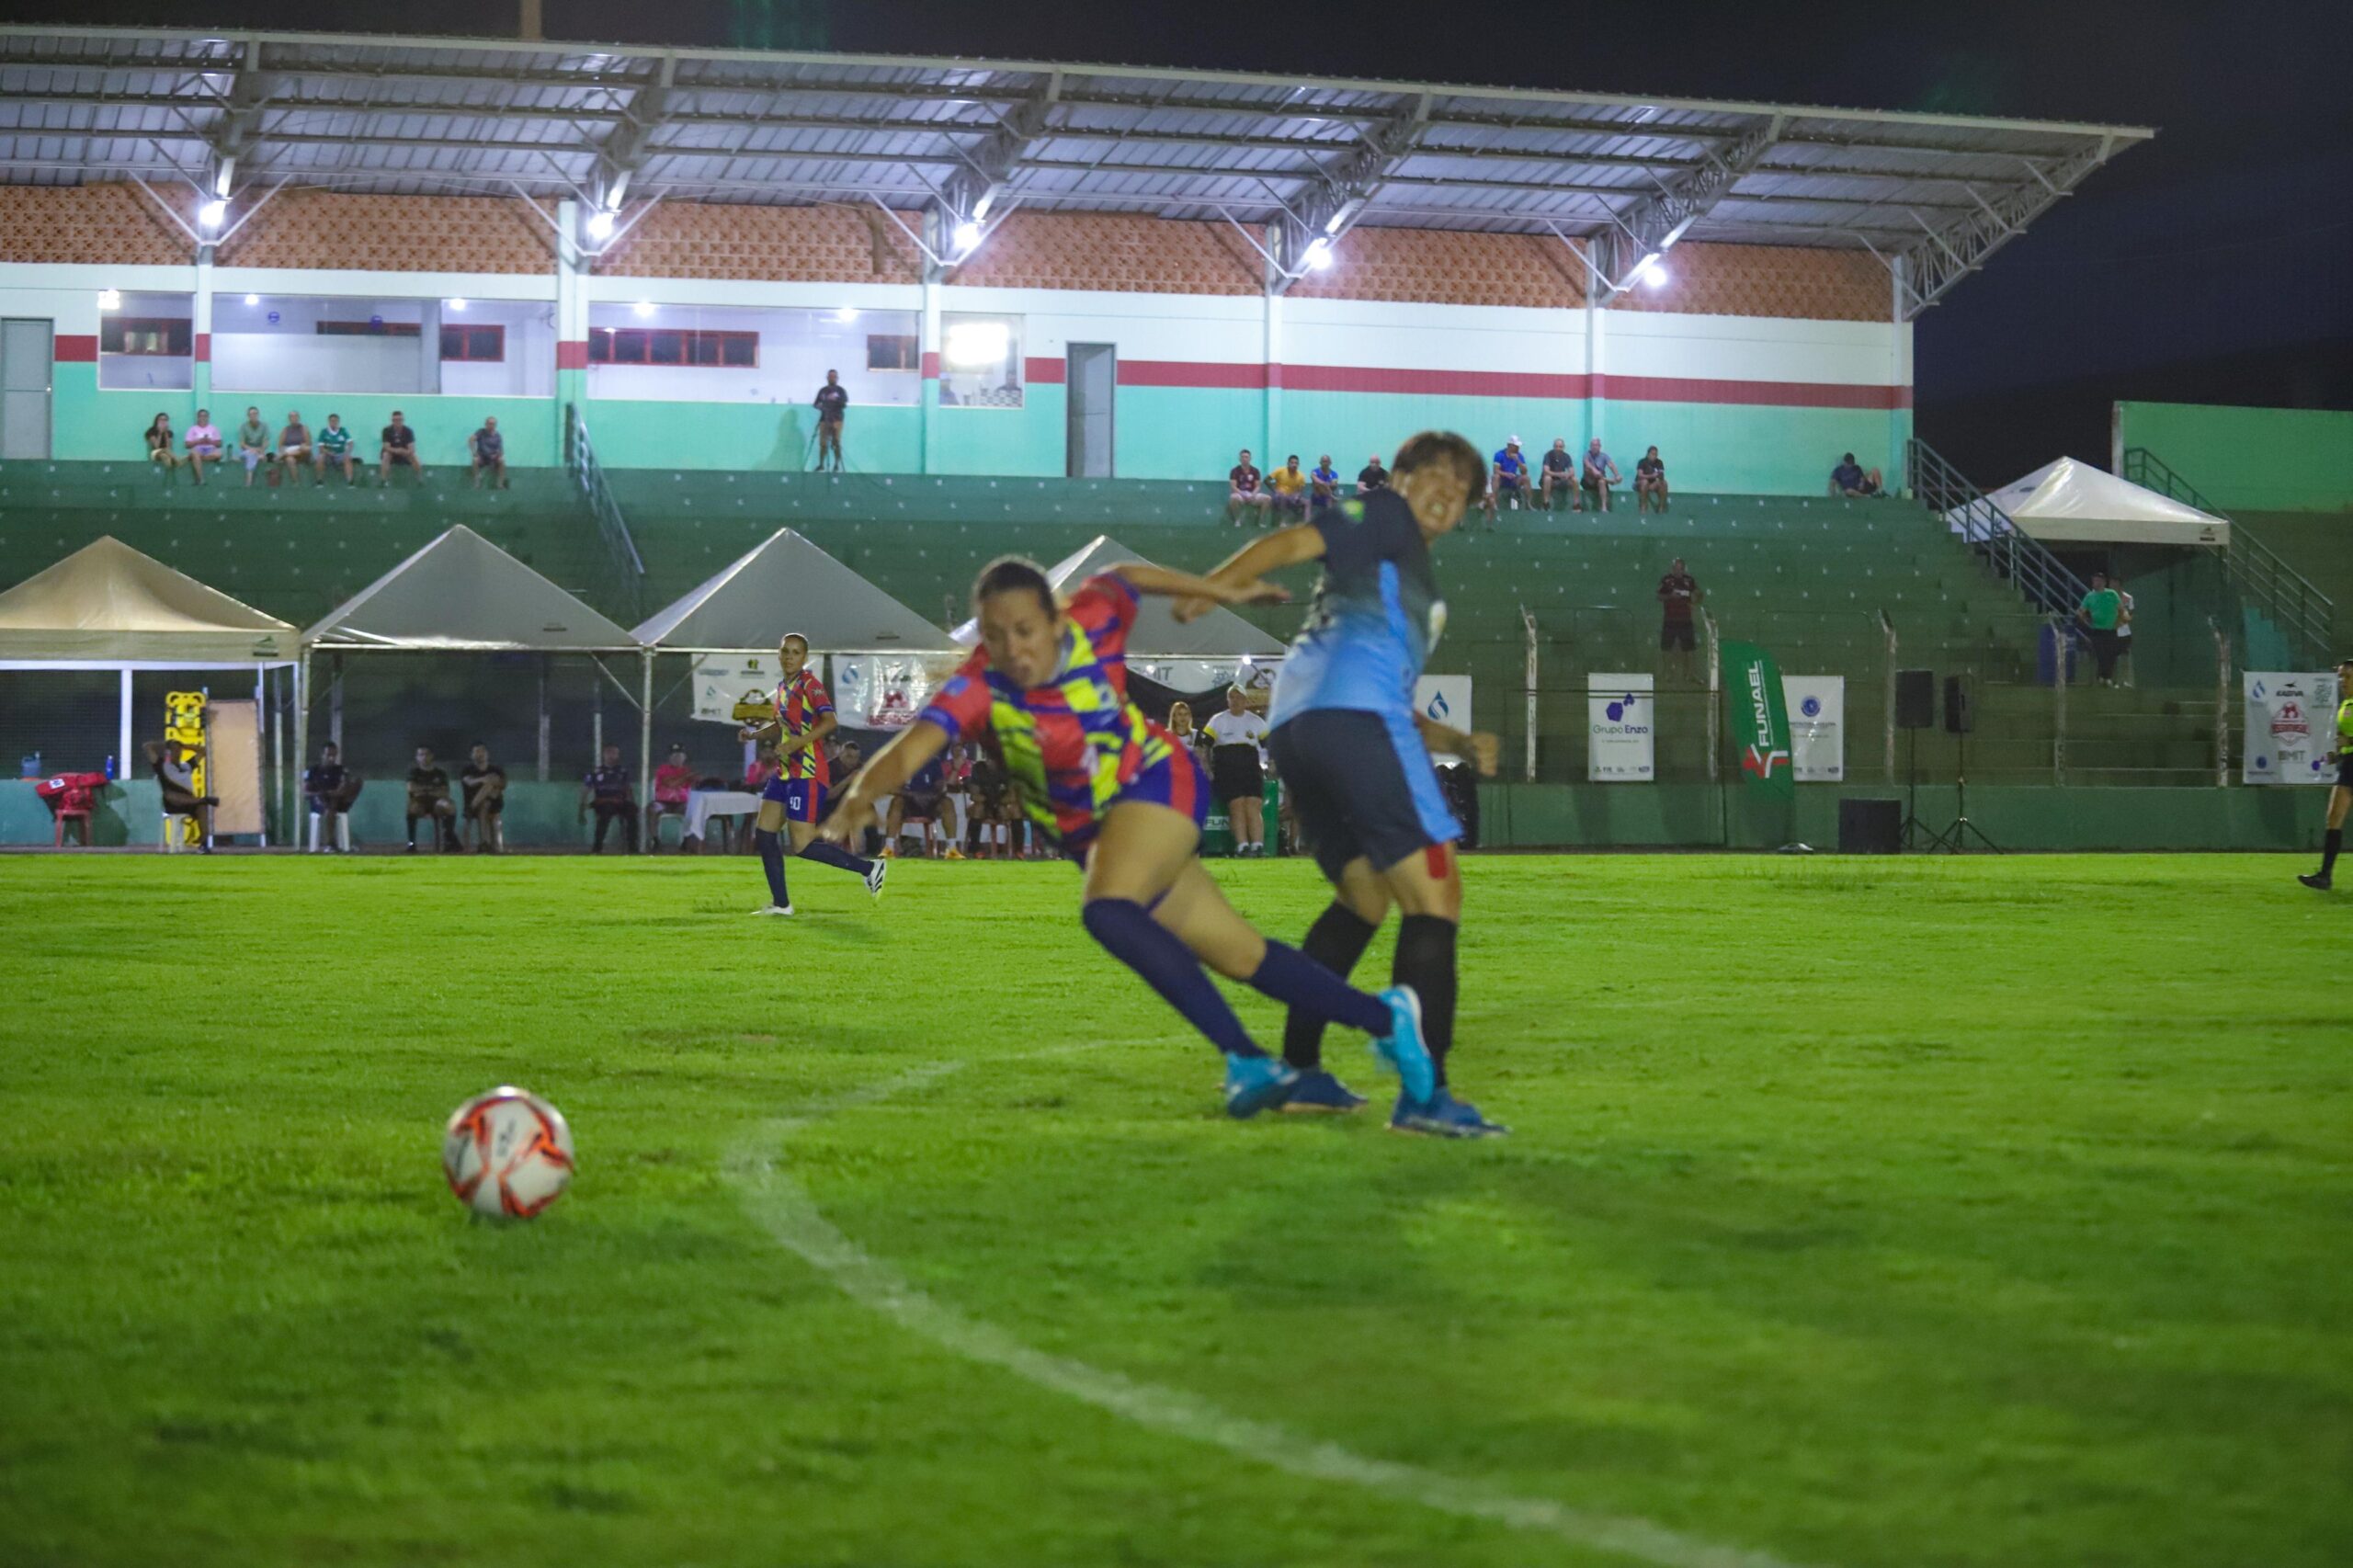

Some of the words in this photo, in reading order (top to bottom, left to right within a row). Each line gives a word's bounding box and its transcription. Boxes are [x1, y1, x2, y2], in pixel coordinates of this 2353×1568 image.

[1748, 661, 1769, 746] FUNAEL
[1593, 724, 1623, 735] Grupo
[1625, 724, 1648, 733] Enzo
